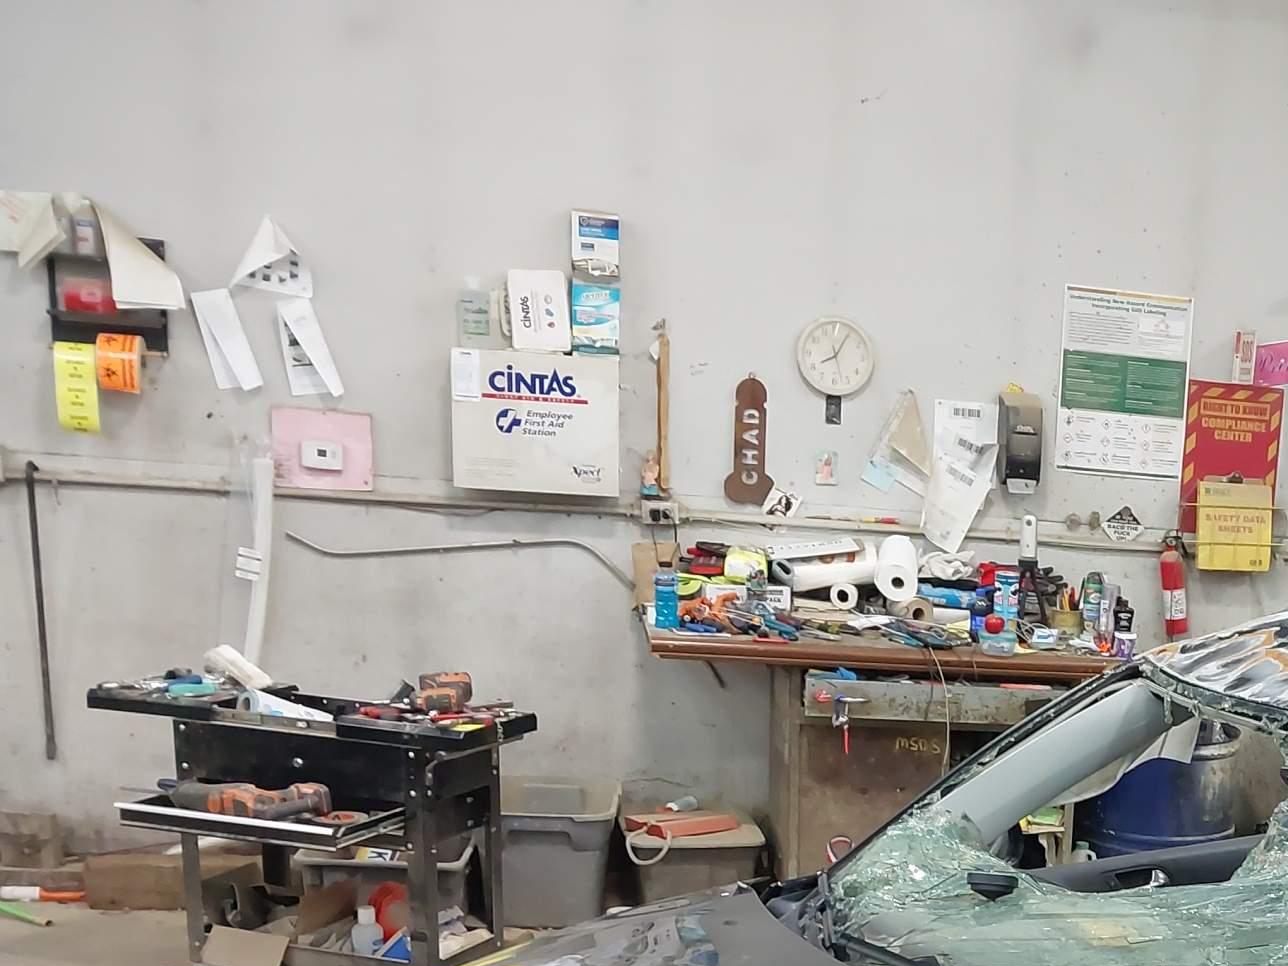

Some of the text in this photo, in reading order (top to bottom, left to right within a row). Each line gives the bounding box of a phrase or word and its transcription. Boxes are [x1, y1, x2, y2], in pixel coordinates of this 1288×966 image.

[488, 364, 577, 398] CINTAS
[526, 410, 573, 421] Employee
[524, 419, 564, 429] First Aid
[1201, 416, 1267, 432] COMPLIANCE
[521, 428, 557, 437] Station
[1214, 430, 1252, 442] CENTER
[741, 408, 760, 485] CHAD
[1205, 512, 1267, 525] SAFETY DATA
[1218, 525, 1254, 534] SHEETS
[895, 736, 941, 754] MSDS
